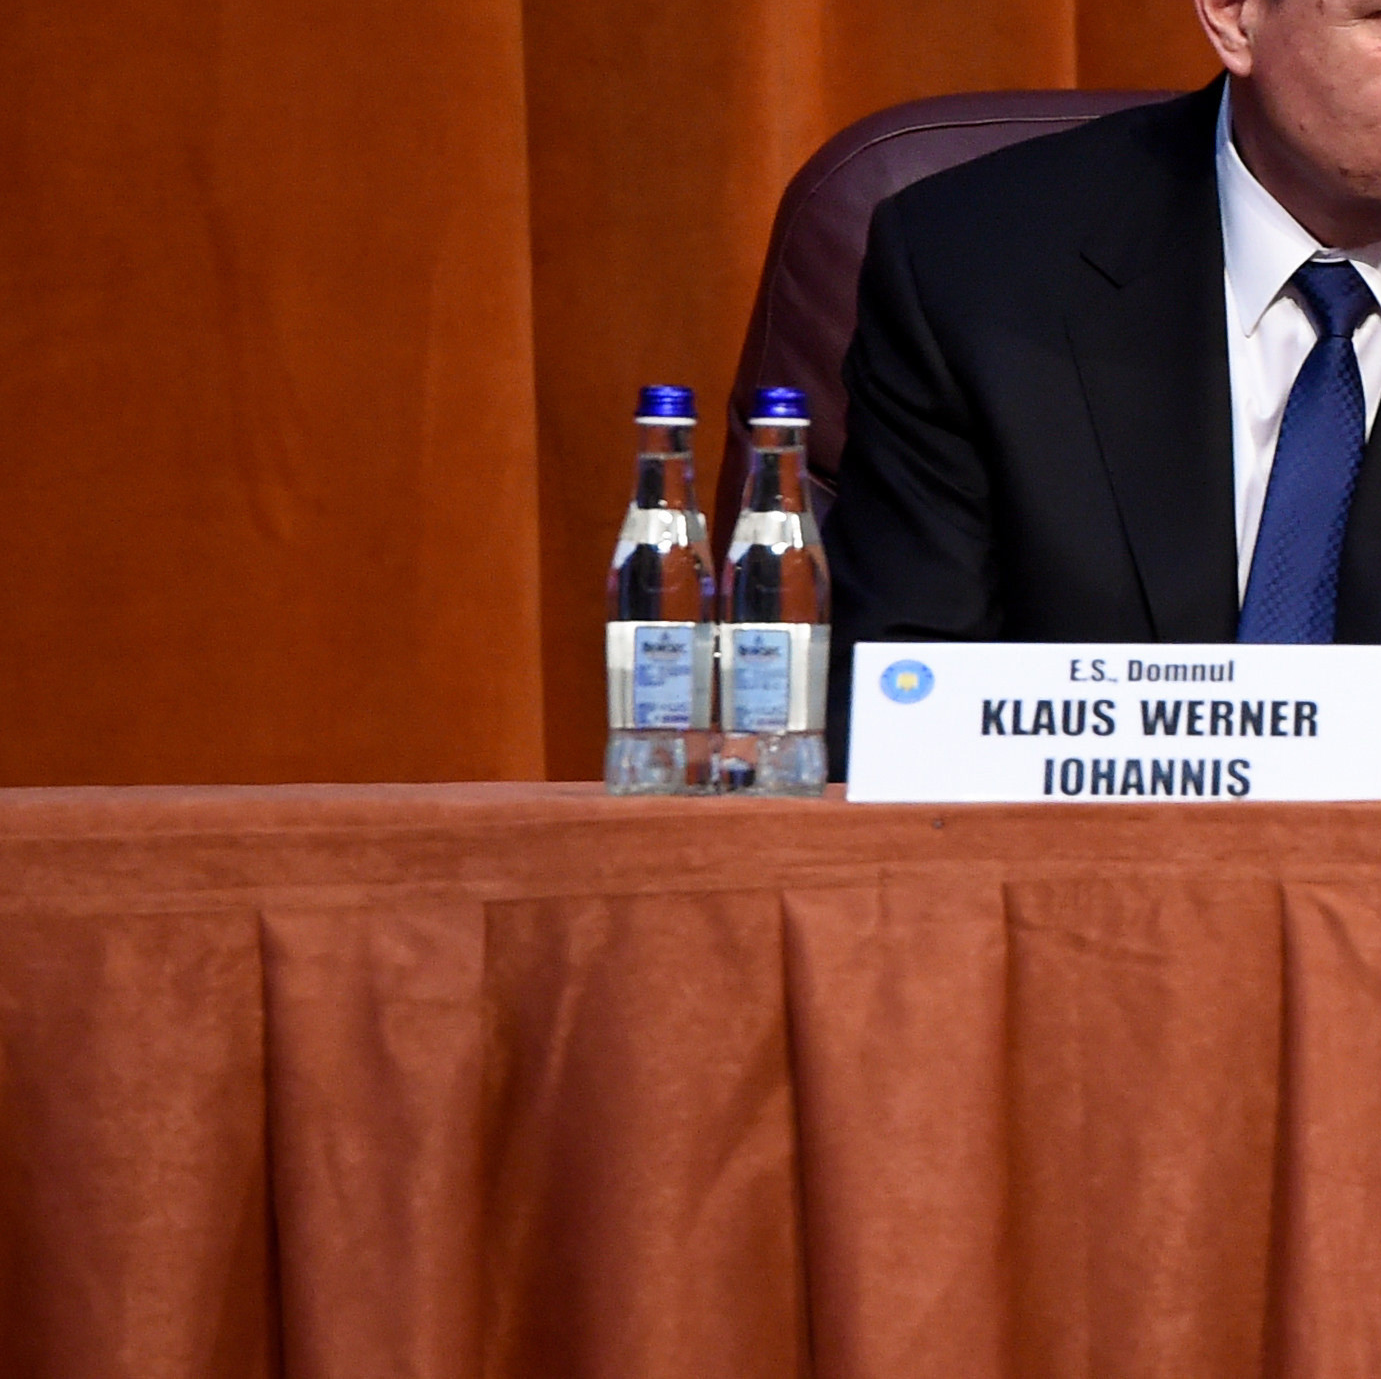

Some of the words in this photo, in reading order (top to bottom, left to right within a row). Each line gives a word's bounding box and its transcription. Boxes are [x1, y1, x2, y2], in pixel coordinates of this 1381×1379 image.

[1128, 659, 1234, 682] Domnul
[981, 699, 1116, 737] KLAUS
[1140, 699, 1318, 737] WERNER
[1043, 758, 1251, 797] IOHANNIS
